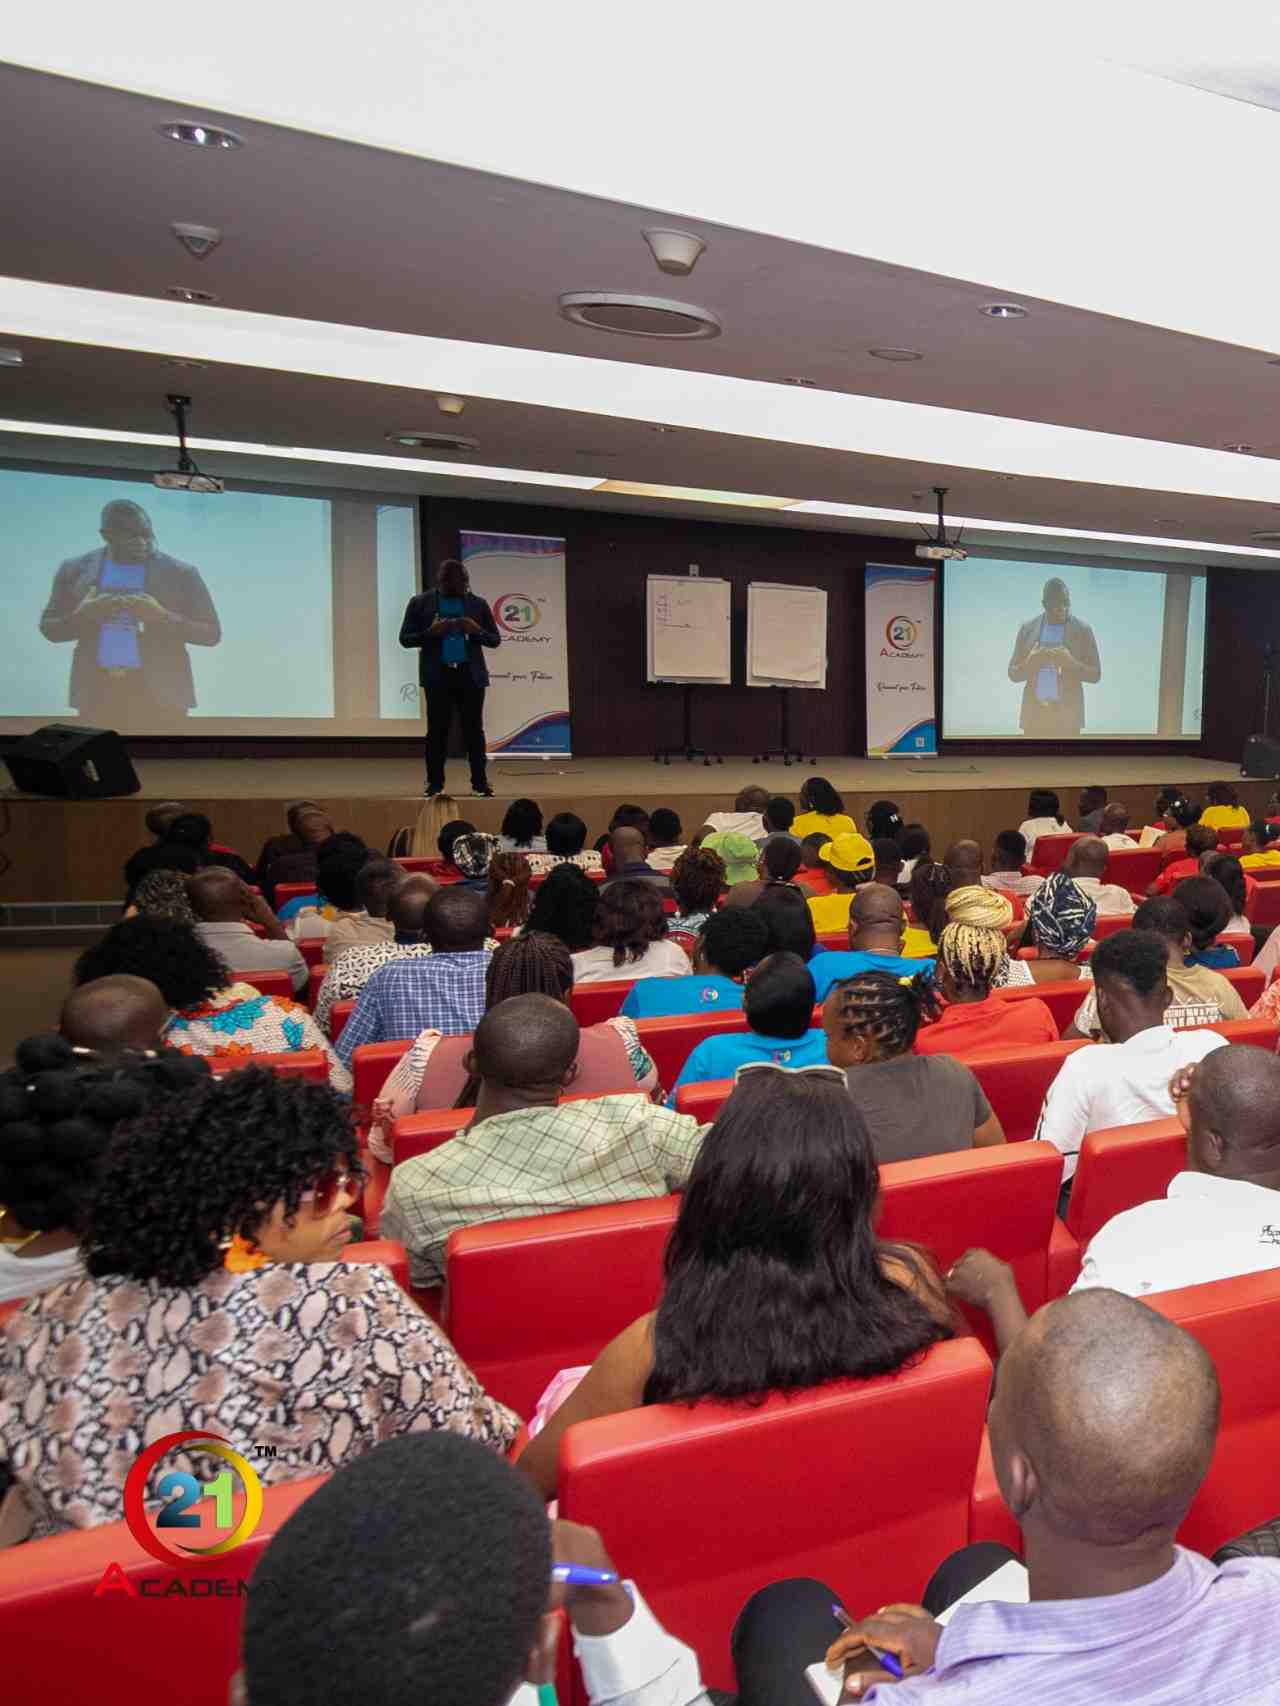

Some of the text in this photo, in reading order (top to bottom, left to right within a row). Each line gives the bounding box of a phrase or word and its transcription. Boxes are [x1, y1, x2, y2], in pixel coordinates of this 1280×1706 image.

[505, 605, 532, 623] 21
[499, 634, 552, 643] CADEMY
[894, 626, 912, 640] 21
